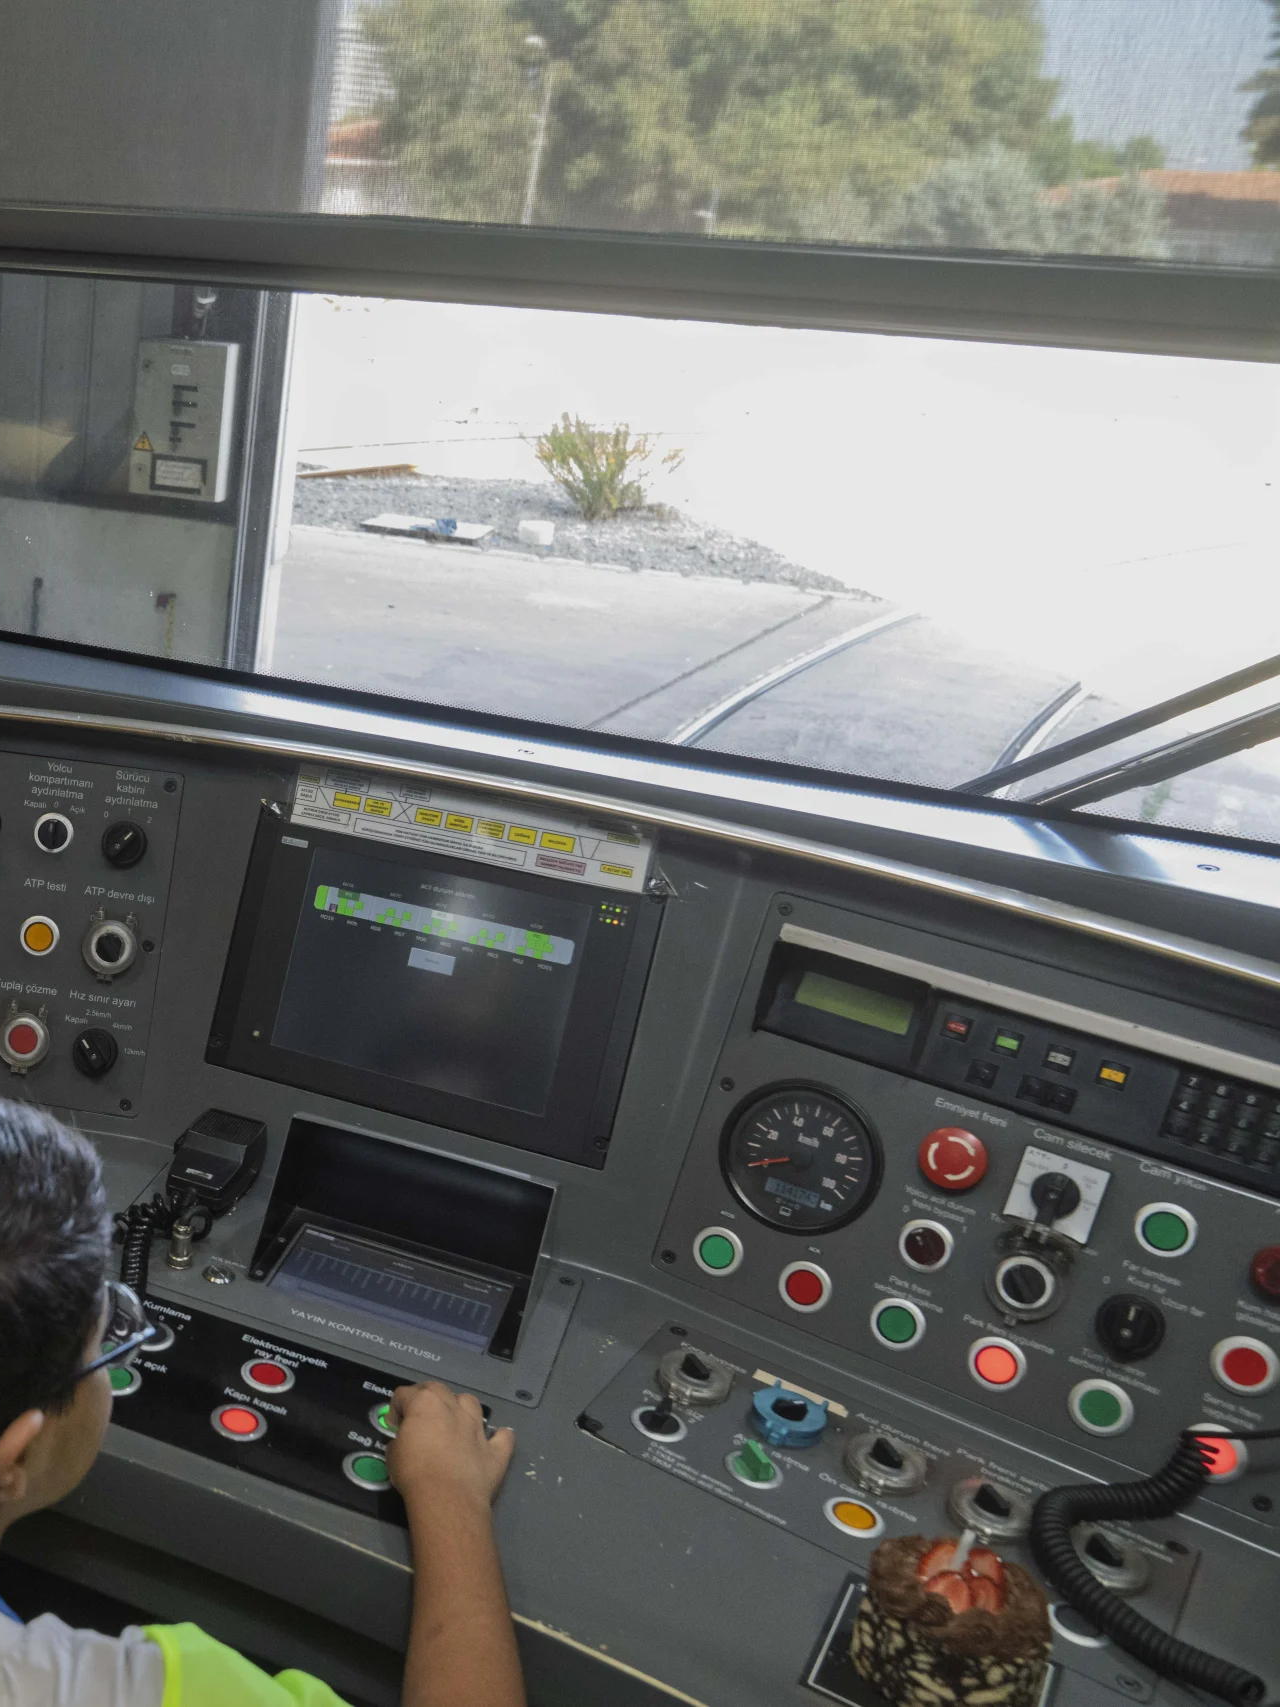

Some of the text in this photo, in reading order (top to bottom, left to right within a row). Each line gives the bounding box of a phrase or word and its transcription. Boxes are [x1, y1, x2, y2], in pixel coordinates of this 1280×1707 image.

[47, 762, 73, 774] Yolcu
[28, 772, 94, 788] kompartımanı
[116, 770, 150, 784] Sürücü
[32, 784, 84, 800] aydınlatma
[116, 782, 146, 795] kabini
[24, 800, 47, 809] Kapalı
[104, 794, 158, 810] aydınlatma
[70, 804, 86, 815] Açık
[24, 878, 67, 892] ATP testi
[84, 886, 155, 904] ATP devre dışı
[26, 983, 58, 996] çözme
[70, 990, 136, 1008] Hız sınır ayarı
[64, 1014, 88, 1024] Kapalı
[86, 1009, 112, 1019] 2.5km/h
[112, 1022, 133, 1031] 4km/h
[124, 1048, 146, 1056] 12km/h
[1188, 1076, 1198, 1086] 7
[1216, 1085, 1227, 1096] 8
[1180, 1100, 1189, 1110] 4
[1246, 1094, 1257, 1105] 9
[934, 1096, 1008, 1128] Emniyet freni
[792, 1116, 805, 1128] 40
[767, 1129, 779, 1140] 20
[822, 1126, 835, 1138] 60
[797, 1132, 820, 1148] km/h
[1033, 1128, 1065, 1146] Cam
[1066, 1140, 1113, 1161] silecek
[1200, 1134, 1210, 1144] 2
[834, 1152, 848, 1164] 80
[1140, 1160, 1172, 1179] Cam
[902, 1204, 910, 1213] 0
[1102, 1275, 1111, 1284] 0
[143, 1300, 192, 1321] Kumlama
[290, 1308, 442, 1362] YAYIN KONTROL KUTUSU
[242, 1333, 329, 1370] Elektromanyetik
[254, 1348, 299, 1368] ray freni
[144, 1360, 168, 1374] açık
[362, 1380, 394, 1398] Elekt
[224, 1386, 288, 1416] Kapı kapalı
[348, 1431, 372, 1447] Sağ
